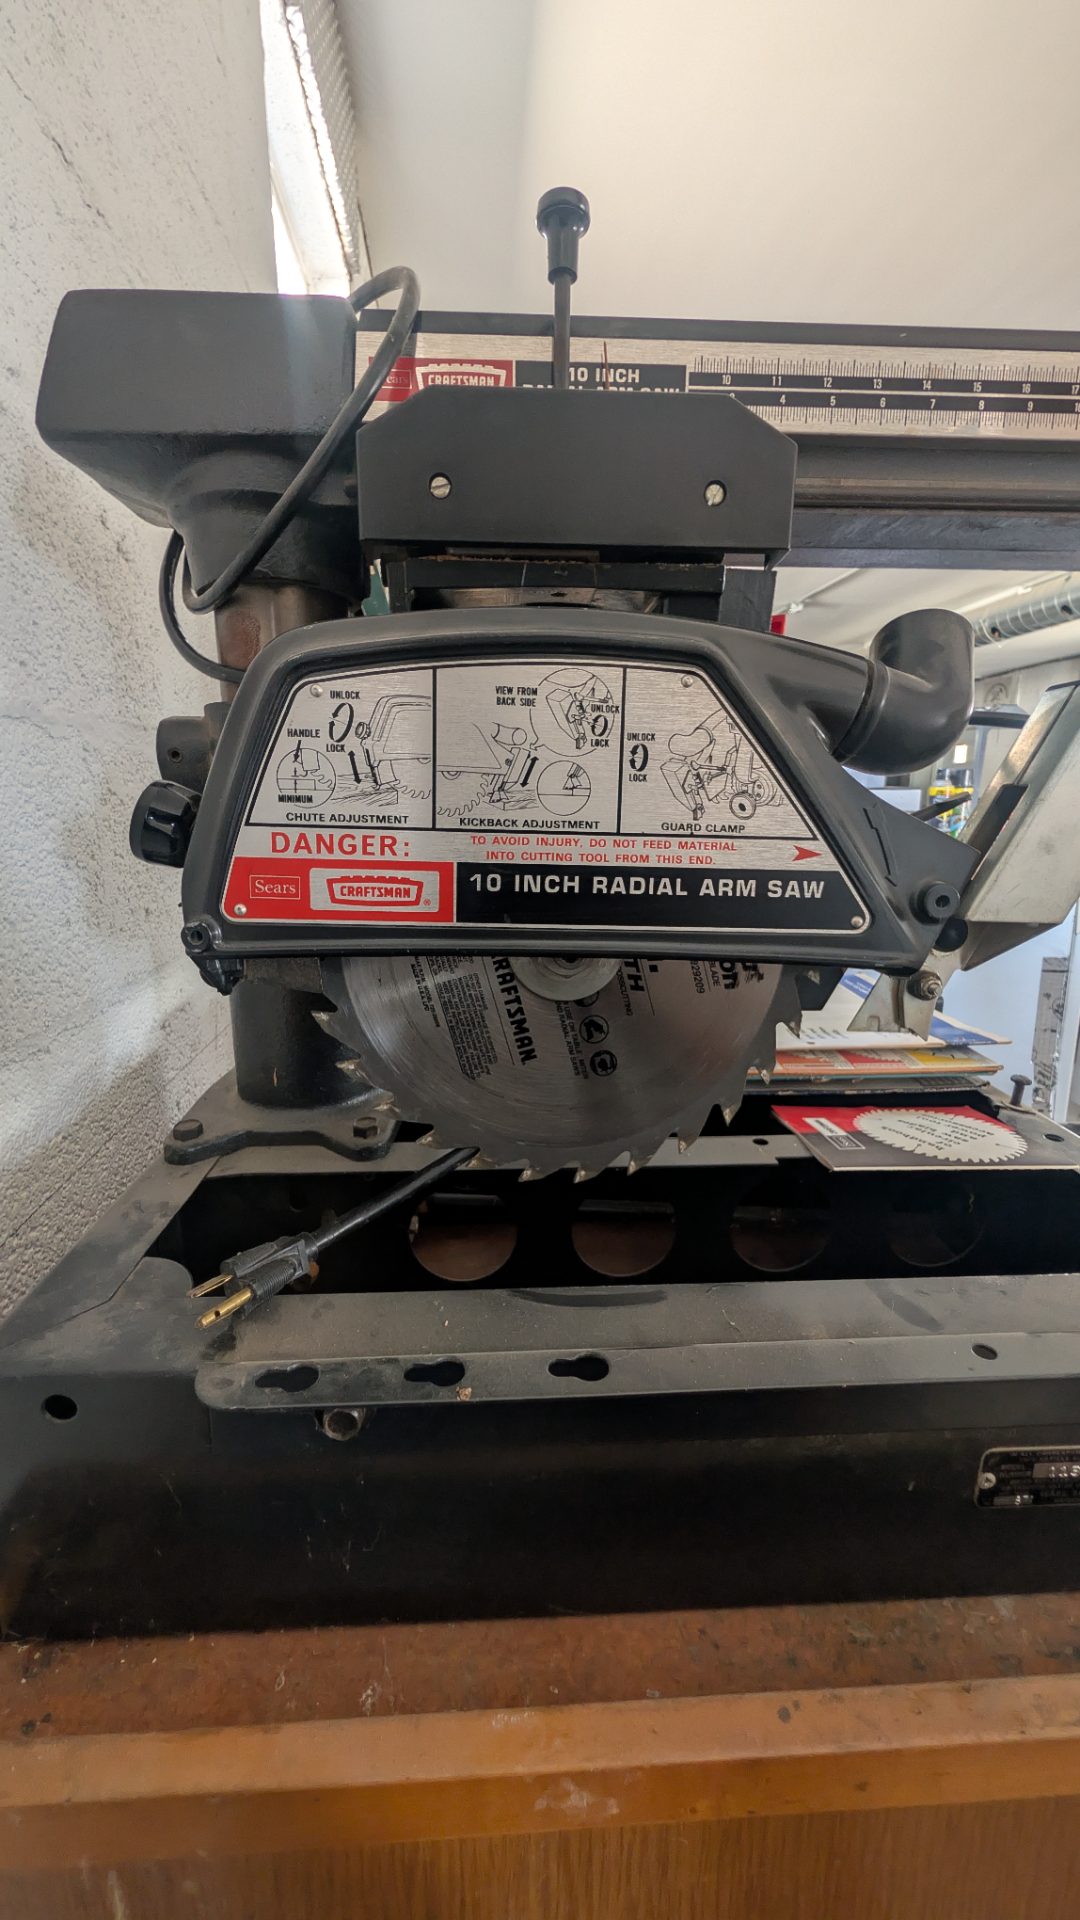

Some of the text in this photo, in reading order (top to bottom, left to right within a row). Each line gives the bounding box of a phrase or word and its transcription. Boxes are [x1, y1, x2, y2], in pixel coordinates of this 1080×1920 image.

[386, 374, 409, 384] ears
[428, 374, 495, 386] CRAFTSMAN
[569, 367, 640, 383] 10 INCH
[722, 375, 1080, 395] 10 11 12 13 14 15 16 17
[779, 394, 786, 405] 4
[830, 395, 836, 406] 5
[880, 397, 886, 408] 6
[930, 399, 937, 410] 7
[979, 400, 985, 411] 8
[1027, 401, 1033, 411] 9
[329, 690, 360, 699] UNLOCK
[495, 686, 538, 696] VIEW FROM
[496, 697, 536, 707] BACK SIDE
[591, 704, 620, 714] UNLOCK
[287, 728, 320, 738] HANDLE
[627, 732, 656, 742] UNLOCK
[326, 744, 345, 753] LOCK
[590, 739, 609, 747] LOCK
[628, 773, 647, 782] LOCK
[278, 794, 314, 803] MINIMUM
[286, 812, 409, 824] CHUTE ADJUSTMENT
[459, 817, 600, 829] KICKBACK ADJUSTMENT
[661, 822, 746, 833] GUARD CLAMP
[271, 831, 410, 857] DANGER:
[470, 835, 486, 845] TO
[492, 836, 530, 846] AVOID
[589, 838, 606, 848] DO
[612, 839, 637, 849] NOT
[642, 840, 672, 850] FEED
[678, 841, 737, 851] MATERIAL
[485, 851, 716, 865] INTO CUTTING TOOL FROM THIS END.
[255, 879, 296, 894] Sears
[340, 885, 411, 898] CRAFTSMAN
[469, 873, 825, 899] 10 INCH RADIAL ARM SAW
